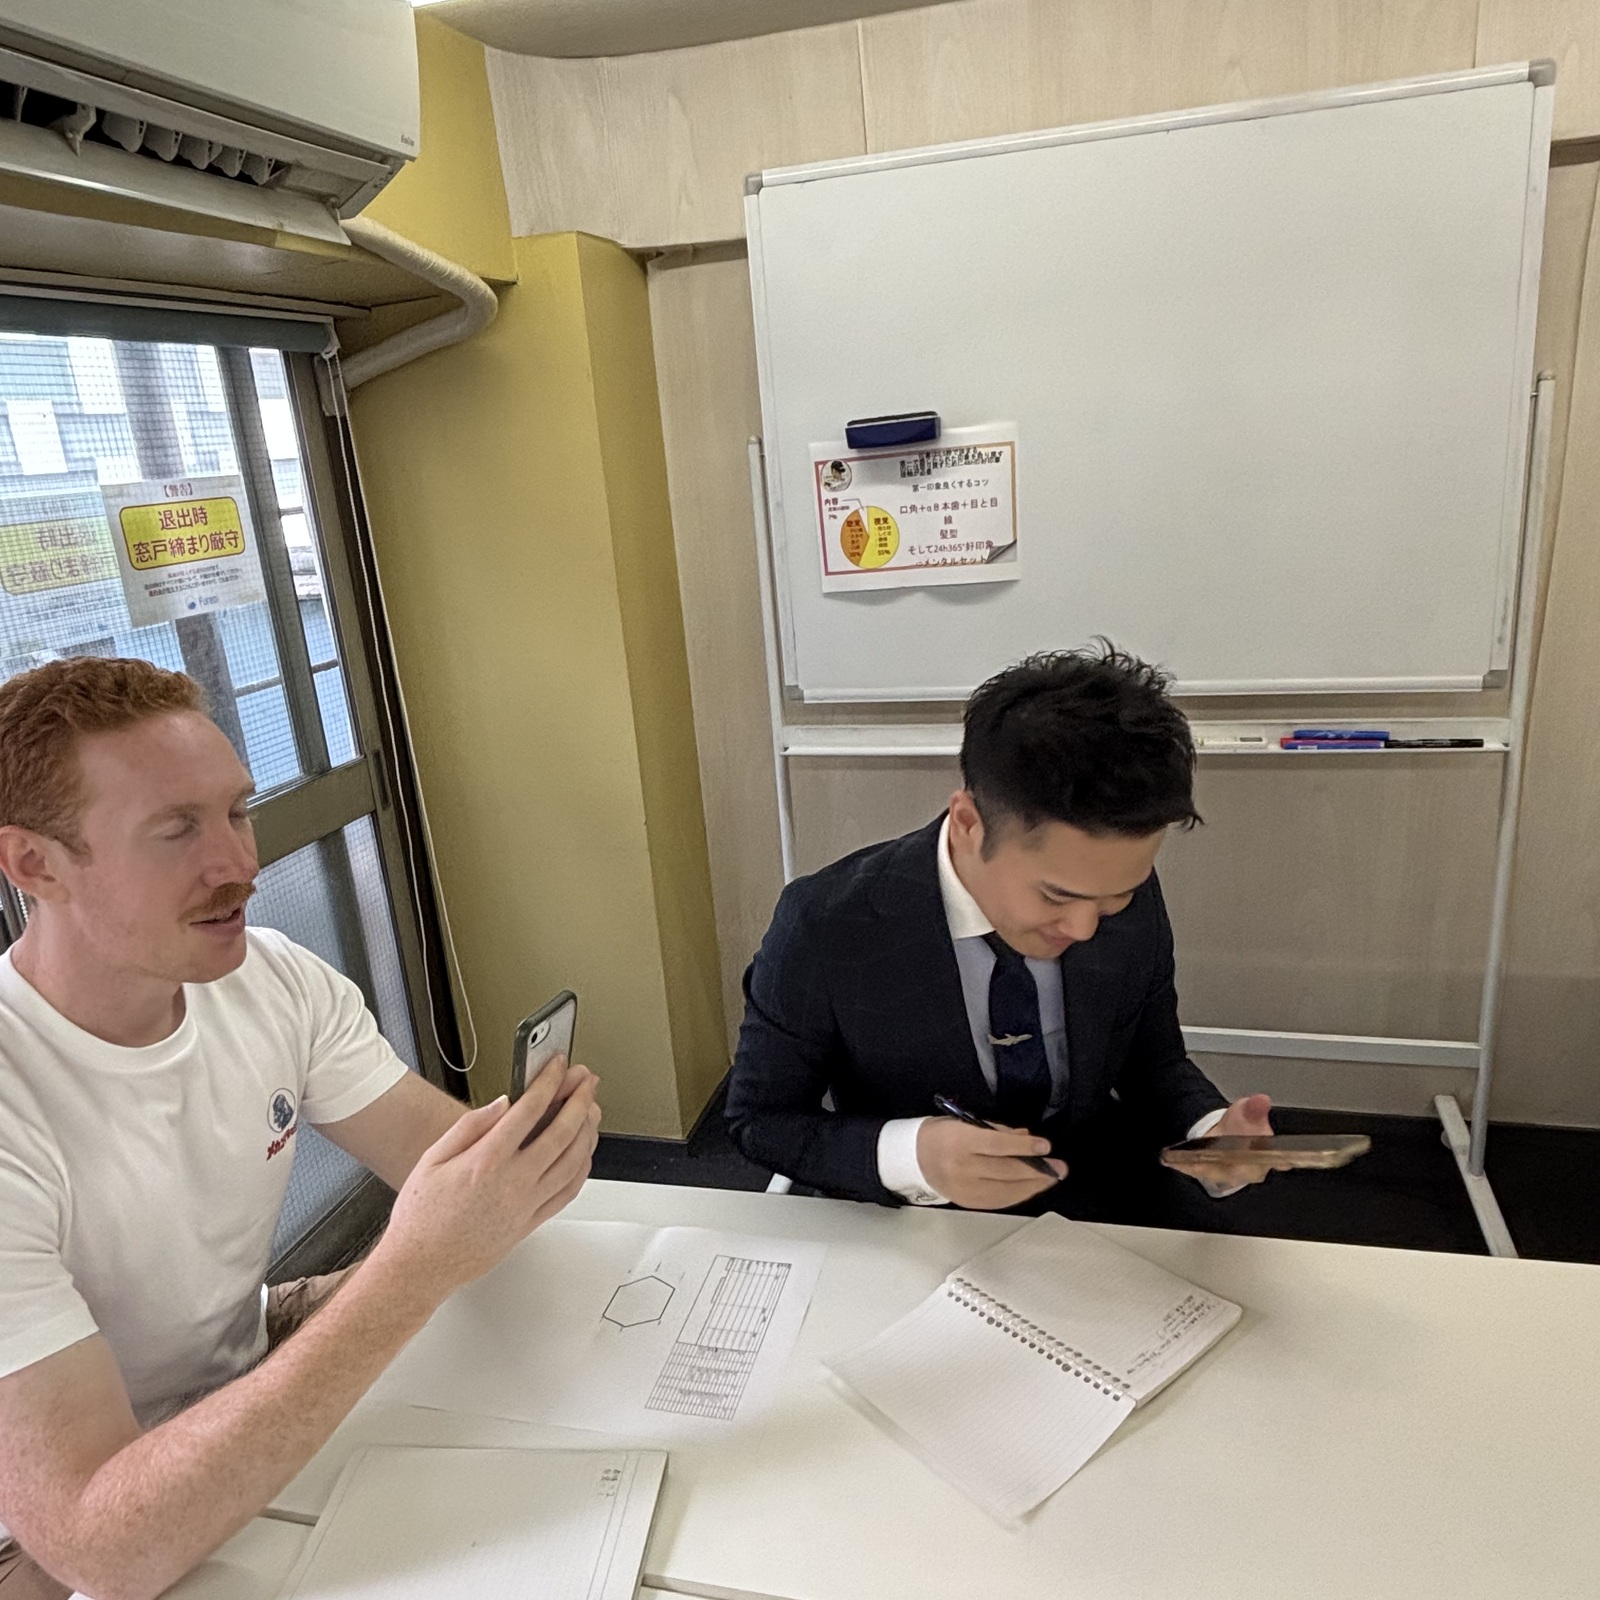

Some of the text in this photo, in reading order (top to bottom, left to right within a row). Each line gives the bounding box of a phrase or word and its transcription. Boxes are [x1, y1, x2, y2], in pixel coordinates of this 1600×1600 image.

[163, 482, 193, 498] 【警告】
[912, 478, 989, 493] 第一印象良くするコツ
[824, 497, 839, 506] 内容
[158, 505, 209, 532] 退出時
[943, 515, 953, 525] 線
[939, 528, 958, 540] 髪型
[132, 530, 240, 564] 窓戸締まり厳守
